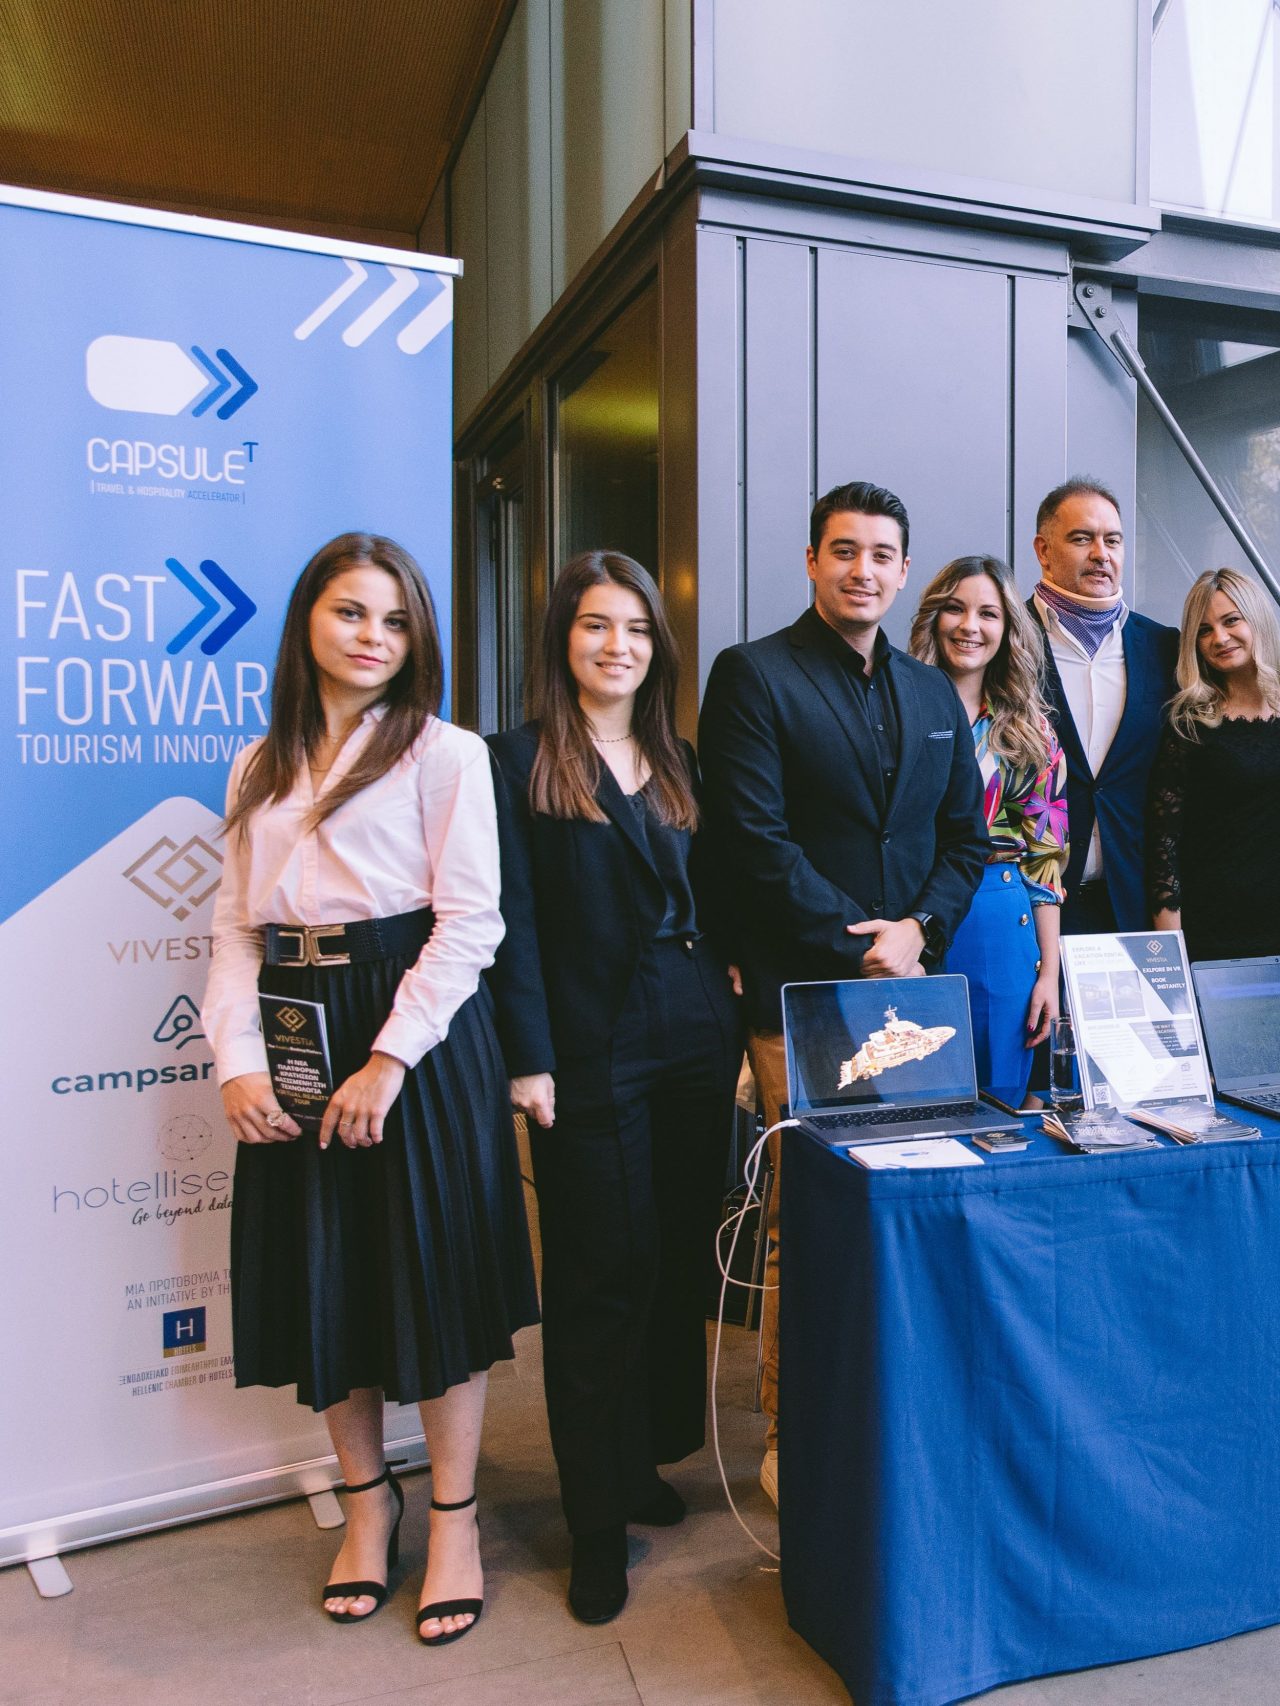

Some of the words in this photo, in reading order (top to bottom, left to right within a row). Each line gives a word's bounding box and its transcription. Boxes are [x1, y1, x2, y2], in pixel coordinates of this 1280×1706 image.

[87, 438, 246, 484] CAPSULE
[96, 482, 125, 495] TRAVEL
[128, 485, 135, 495] &
[137, 486, 186, 499] HOSPITALITY
[187, 490, 240, 503] ACCELERATOR
[16, 568, 167, 643] FAST
[17, 655, 270, 726] FORWAR
[16, 733, 143, 765] TOURISM
[275, 1034, 315, 1046] VIVESTIA
[51, 1061, 215, 1094] campsar
[52, 1170, 230, 1214] hotellise
[132, 1207, 150, 1226] Go
[156, 1198, 204, 1227] beyond
[127, 1299, 142, 1311] AN
[146, 1289, 198, 1307] INITIATIVE
[201, 1286, 214, 1299] BY
[176, 1318, 194, 1340] H
[132, 1382, 164, 1397] HELLENIC
[209, 1368, 233, 1381] HOTELS
